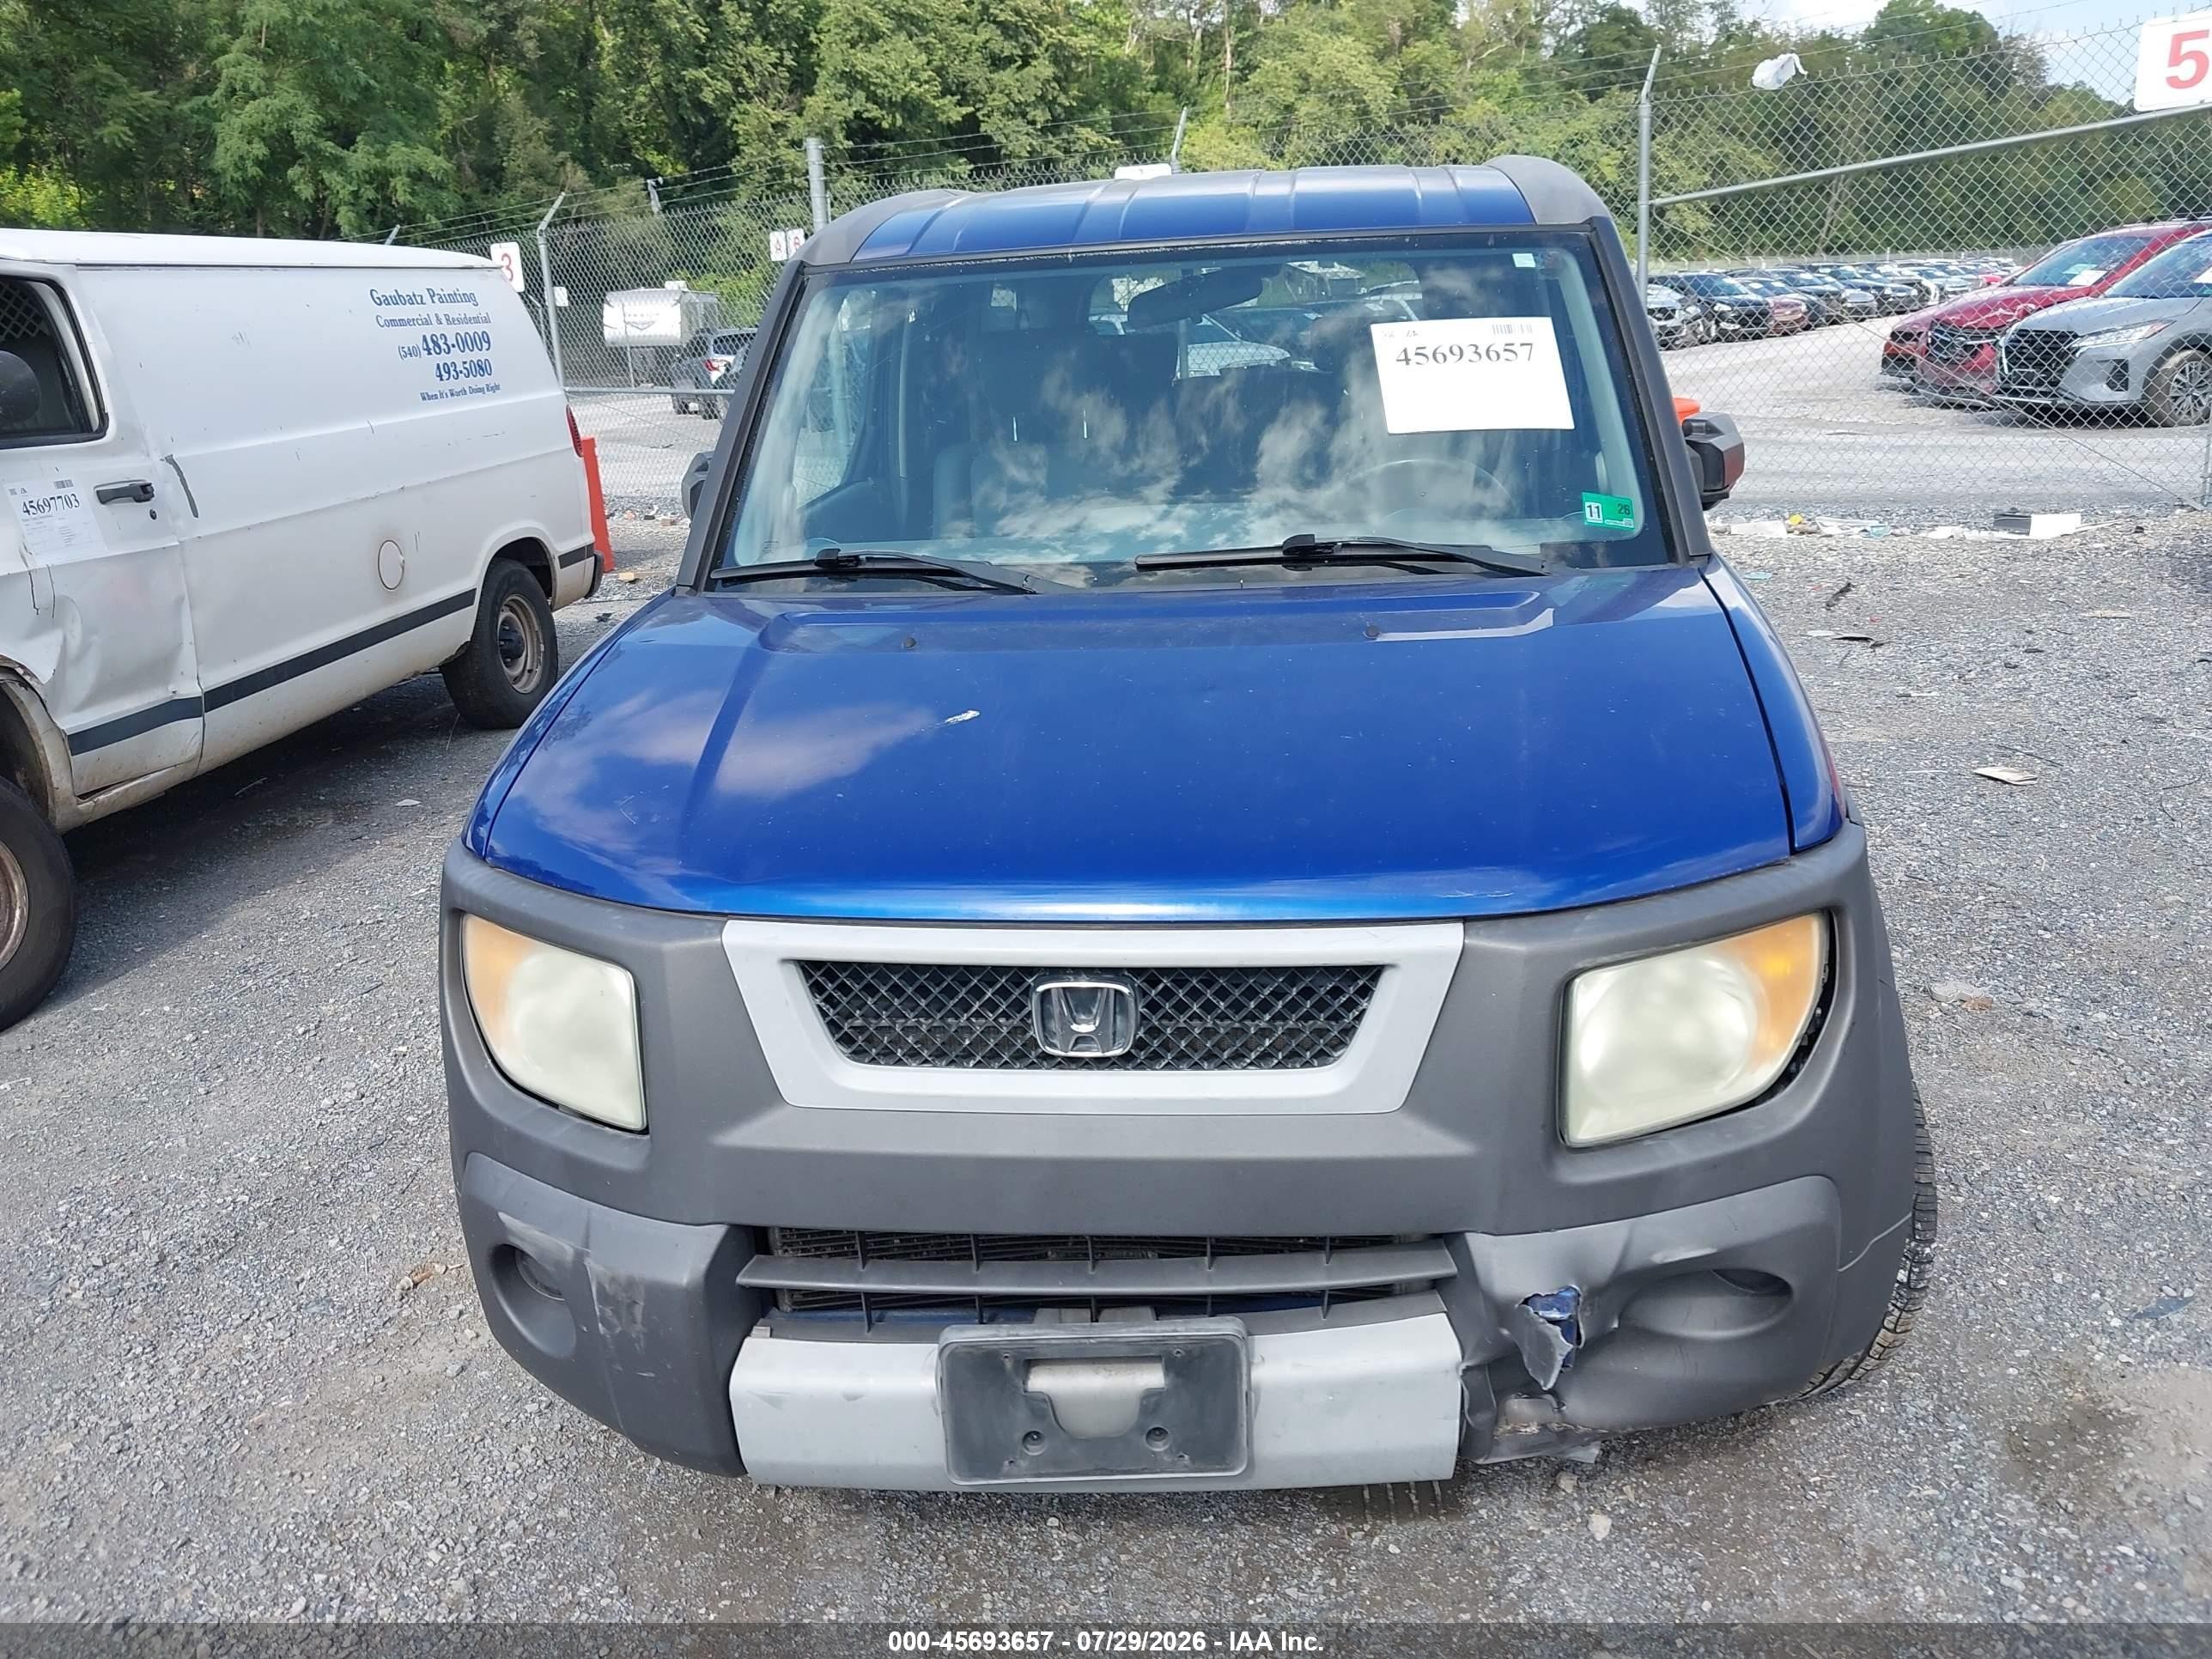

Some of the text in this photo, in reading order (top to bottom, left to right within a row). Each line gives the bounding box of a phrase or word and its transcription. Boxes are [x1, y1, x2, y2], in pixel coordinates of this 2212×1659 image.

[2166, 29, 2210, 89] 5
[501, 252, 514, 283] 3
[369, 288, 479, 307] Gaubatz Painting
[375, 312, 491, 328] Commercial & Residential
[398, 331, 491, 361] (540) 483-0009
[1395, 343, 1533, 366] 45693657
[435, 358, 493, 381] 493-5080
[420, 382, 501, 402] When It's Worth Doing Right
[22, 493, 80, 516] 45697703
[1586, 503, 1601, 519] 11
